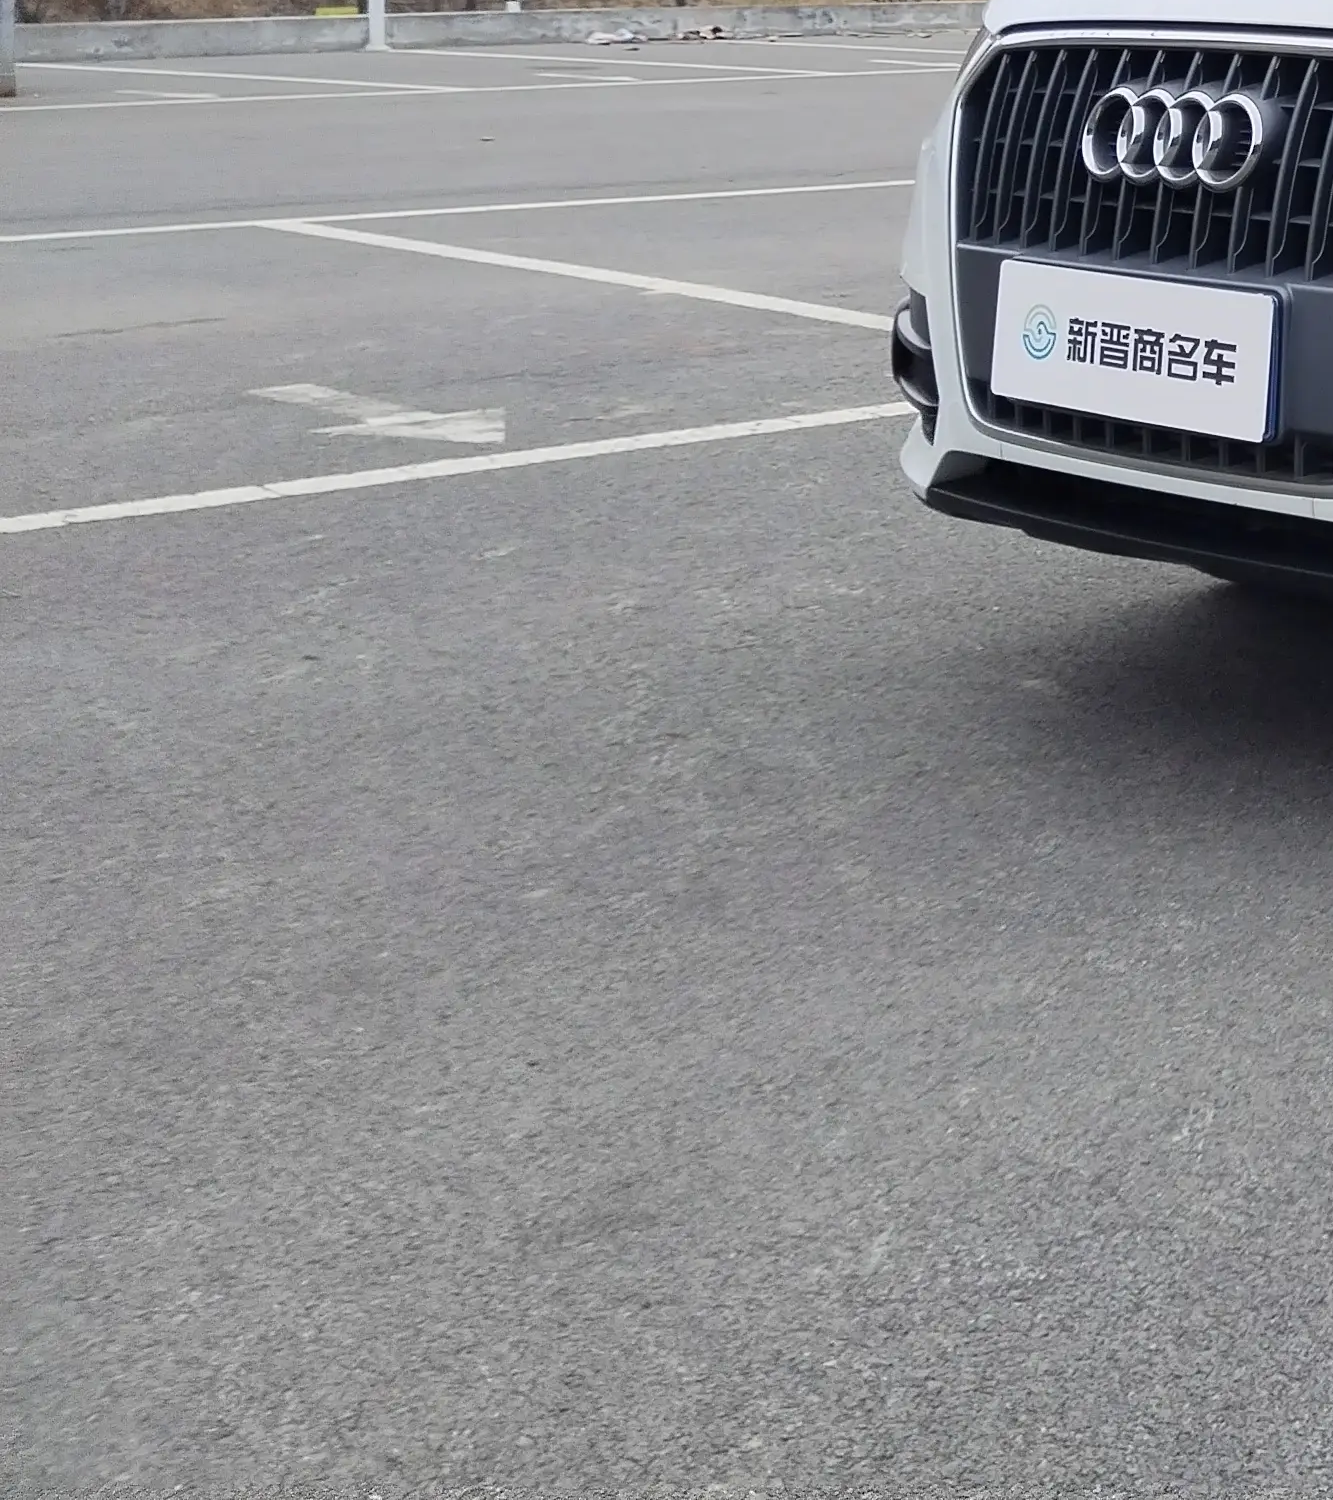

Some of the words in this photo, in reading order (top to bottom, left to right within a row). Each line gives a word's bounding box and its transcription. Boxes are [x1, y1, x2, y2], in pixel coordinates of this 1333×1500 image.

[1066, 316, 1237, 386] 新晋商名车
